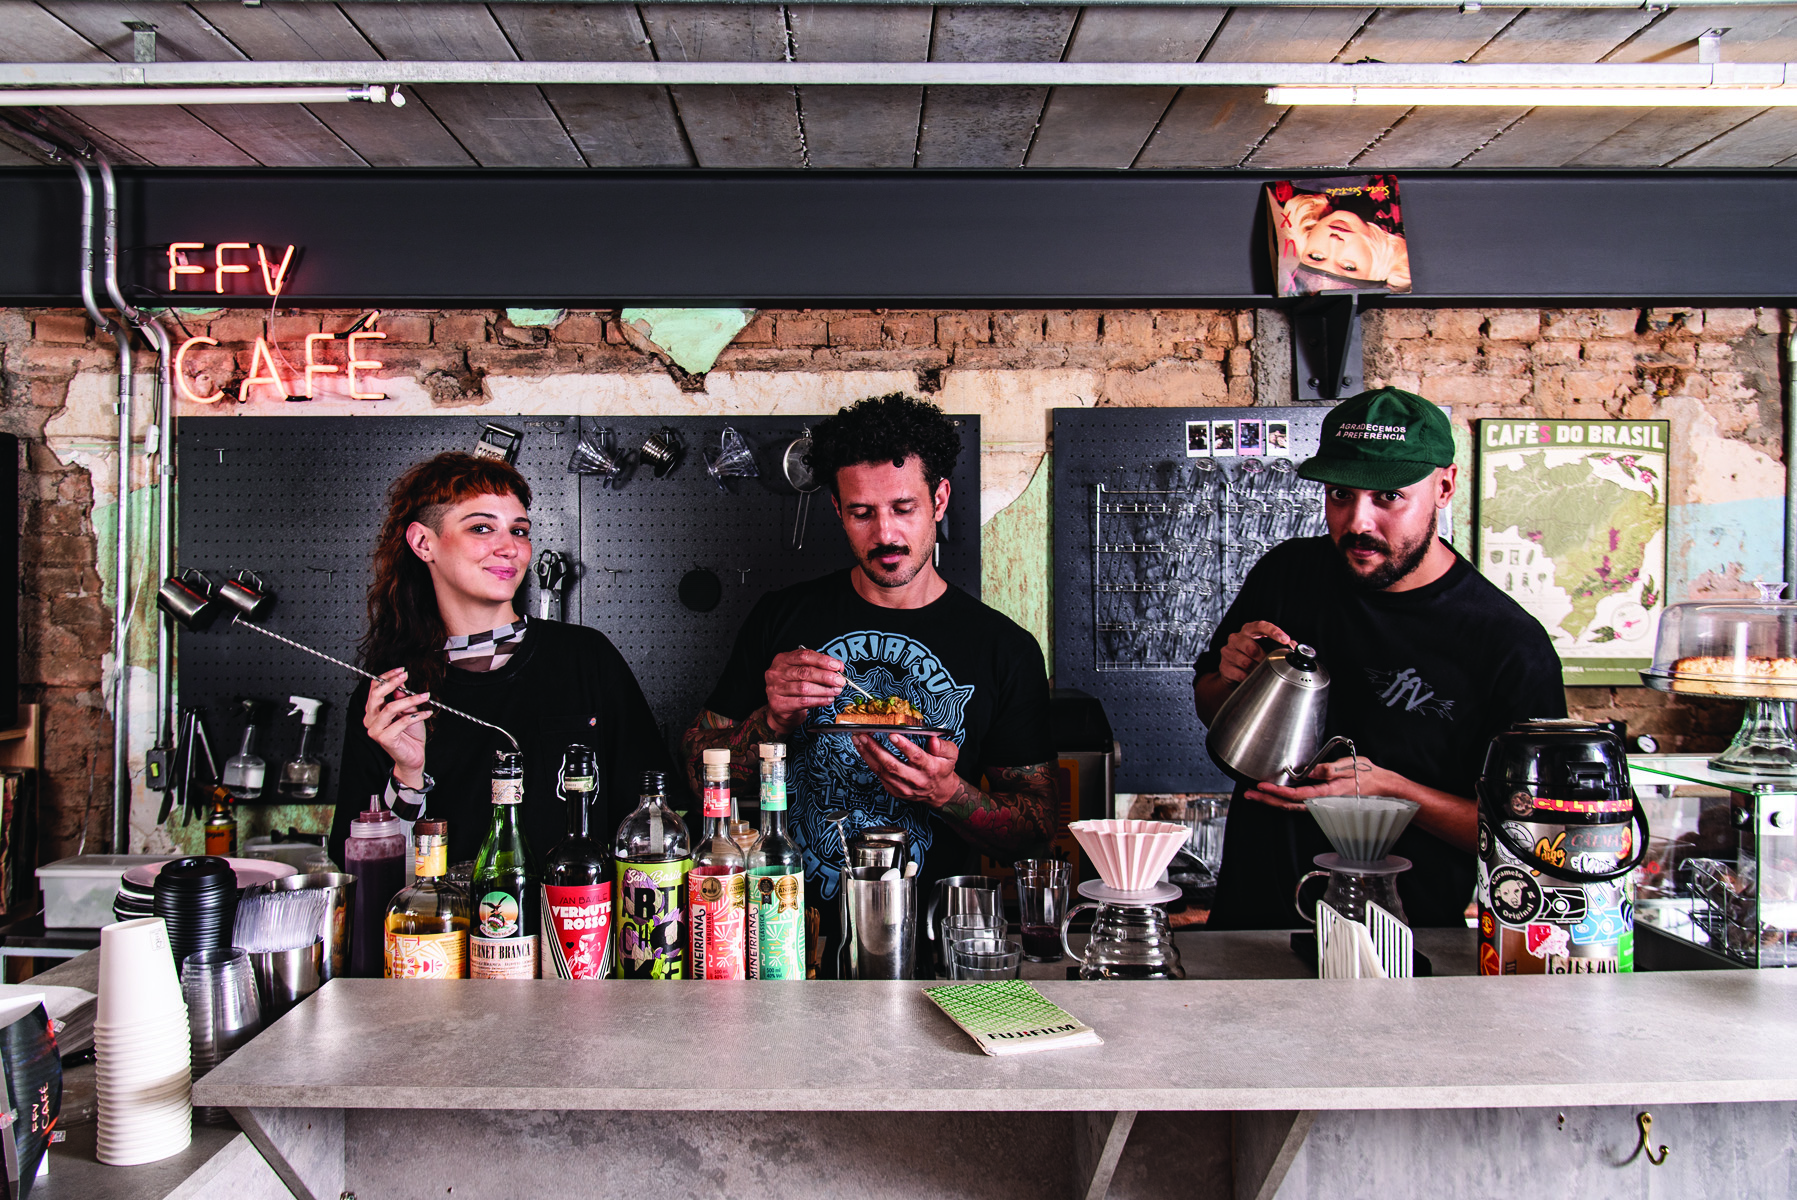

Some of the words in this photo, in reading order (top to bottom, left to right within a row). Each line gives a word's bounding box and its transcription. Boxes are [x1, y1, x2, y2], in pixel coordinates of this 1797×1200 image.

[1325, 185, 1362, 197] Sentido
[168, 242, 296, 296] FFV
[174, 309, 388, 404] CAFÉ
[1339, 422, 1407, 433] AGRADECEMOS
[1342, 430, 1406, 442] PREFERÊNCIA
[1556, 425, 1584, 443] DO
[1588, 425, 1665, 449] BRASIL
[626, 869, 648, 884] San
[649, 869, 682, 885] Basile
[1491, 870, 1524, 885] Caramelo
[552, 900, 612, 917] VERMUTE
[1502, 902, 1534, 921] Original
[563, 914, 607, 931] ROSSO
[471, 942, 496, 959] FERNET
[499, 942, 531, 959] BRANCA
[694, 908, 706, 979] MINEIRIANA
[749, 907, 759, 979] MINEIRIANA
[987, 1023, 1077, 1040] FUJIFILM
[39, 1082, 49, 1130] CAFÉ
